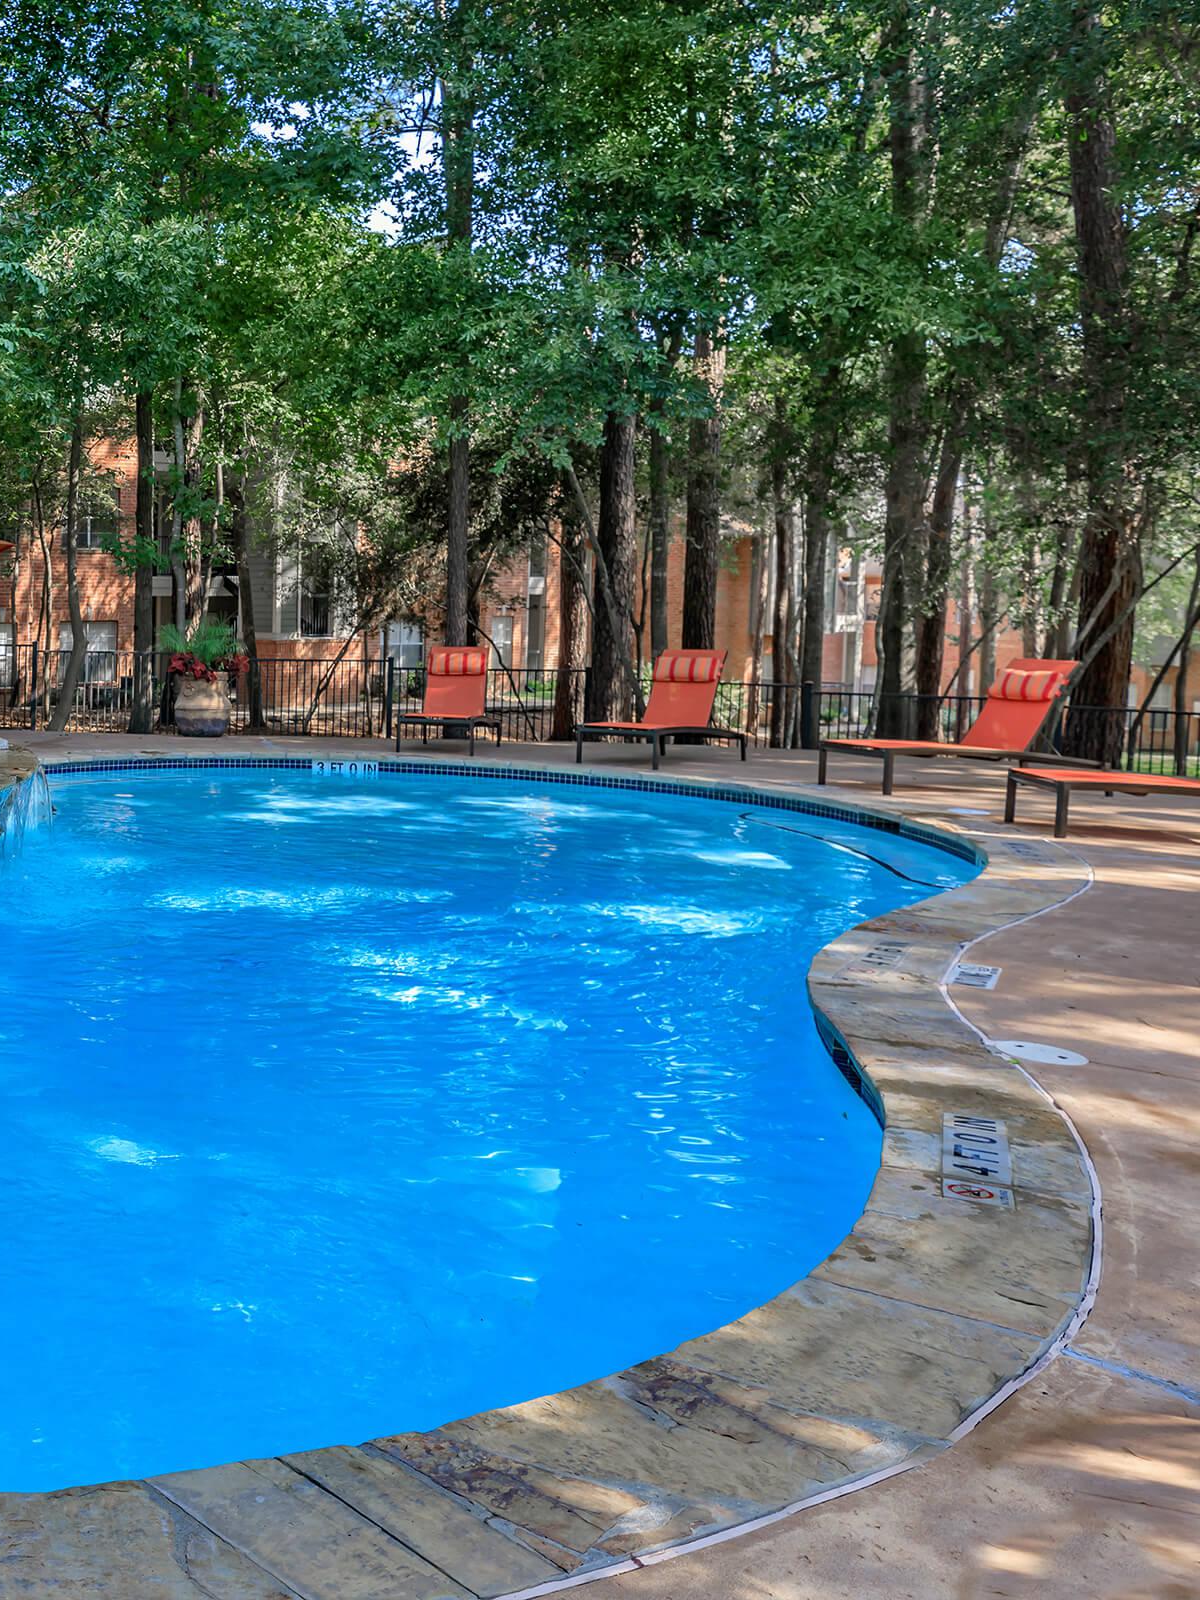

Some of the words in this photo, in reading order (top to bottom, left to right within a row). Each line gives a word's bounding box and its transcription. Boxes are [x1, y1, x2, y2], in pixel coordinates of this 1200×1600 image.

[330, 762, 344, 773] FT
[363, 763, 377, 775] IN
[953, 1115, 997, 1132] IN
[953, 1132, 997, 1144] 0
[953, 1144, 999, 1164] FT
[952, 1163, 998, 1176] 4
